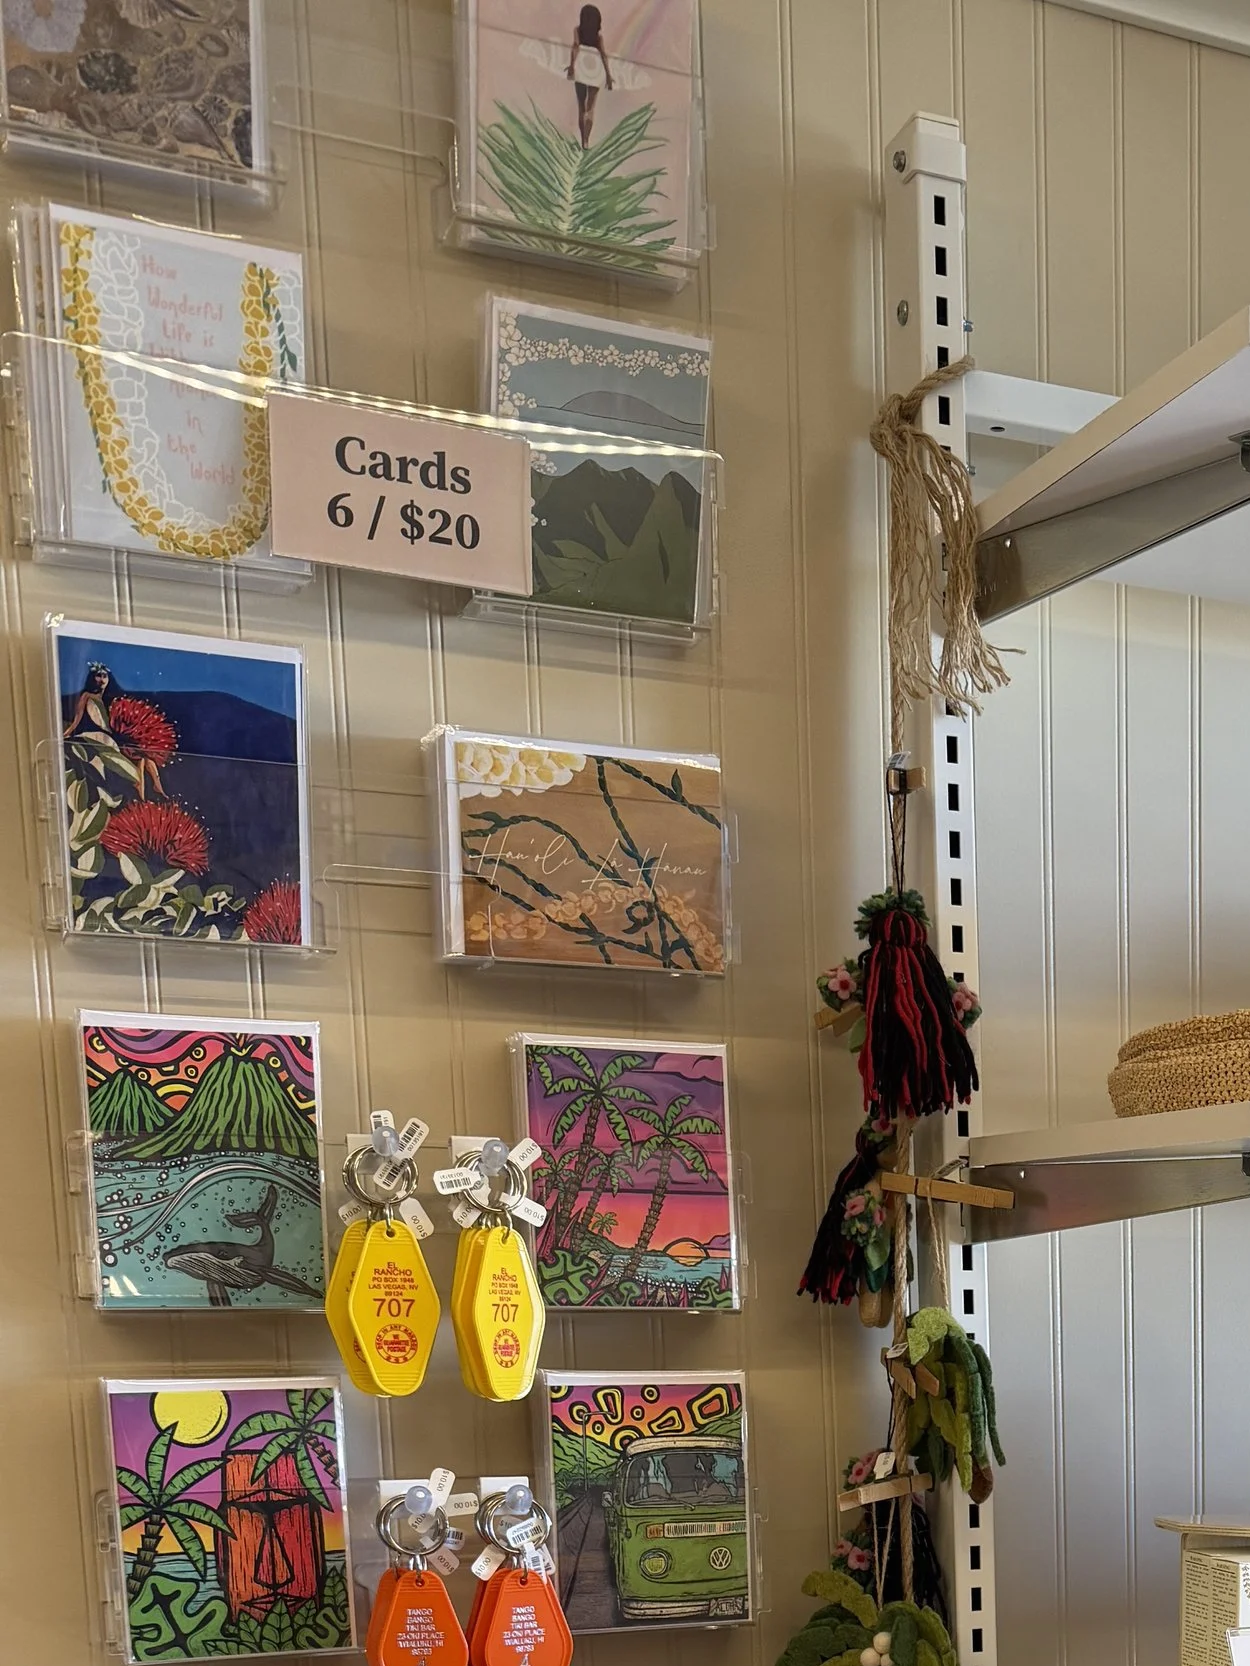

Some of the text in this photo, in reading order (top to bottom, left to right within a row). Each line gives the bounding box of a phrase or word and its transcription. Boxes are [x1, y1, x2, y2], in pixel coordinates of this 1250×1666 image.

[141, 254, 177, 279] How
[147, 285, 223, 323] Wonderful
[162, 318, 193, 342] Life
[335, 436, 472, 495] Cards
[327, 493, 480, 550] 6 / $20
[374, 1268, 412, 1277] RANCHO
[493, 1274, 517, 1282] RANCHO
[373, 1298, 415, 1317] 707
[492, 1304, 519, 1322] 707
[512, 1606, 534, 1614] TANGO
